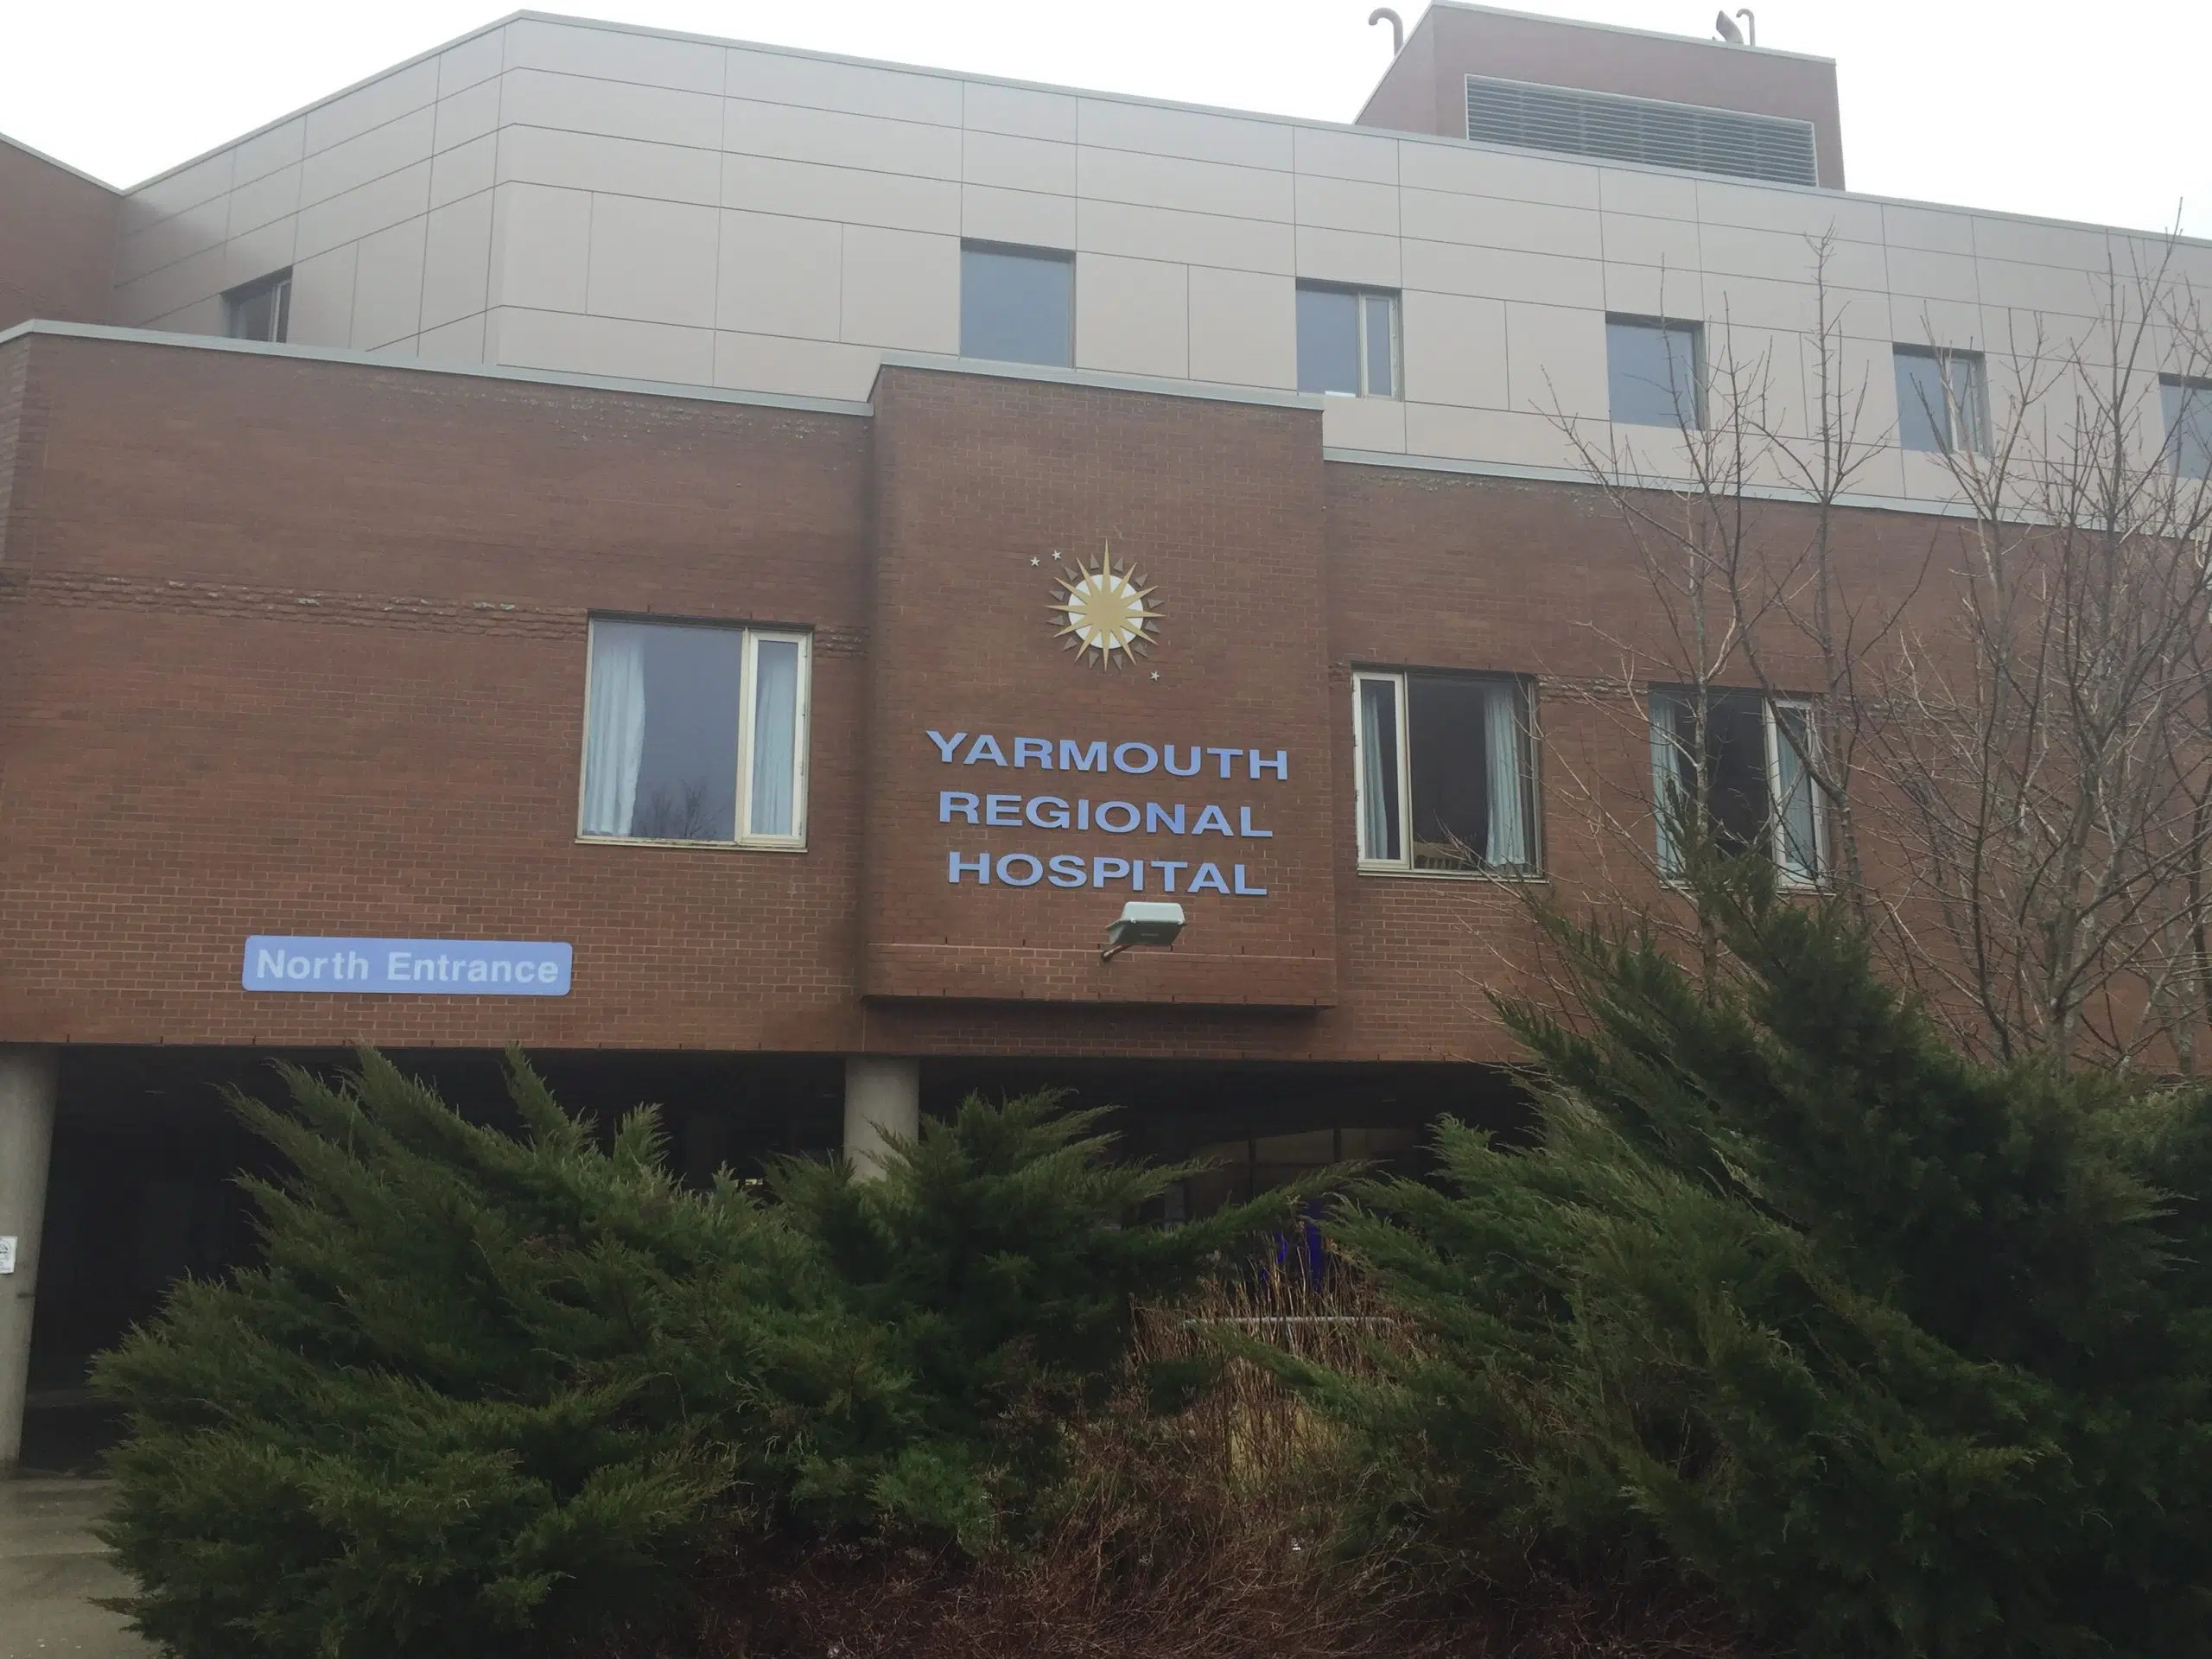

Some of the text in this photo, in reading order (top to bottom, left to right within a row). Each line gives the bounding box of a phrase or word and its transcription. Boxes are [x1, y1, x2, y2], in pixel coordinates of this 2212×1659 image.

[926, 730, 1287, 780] YARMOUTH
[939, 791, 1273, 837] REGIONAL
[948, 851, 1268, 896] HOSPITAL
[256, 949, 559, 983] North Entrance
